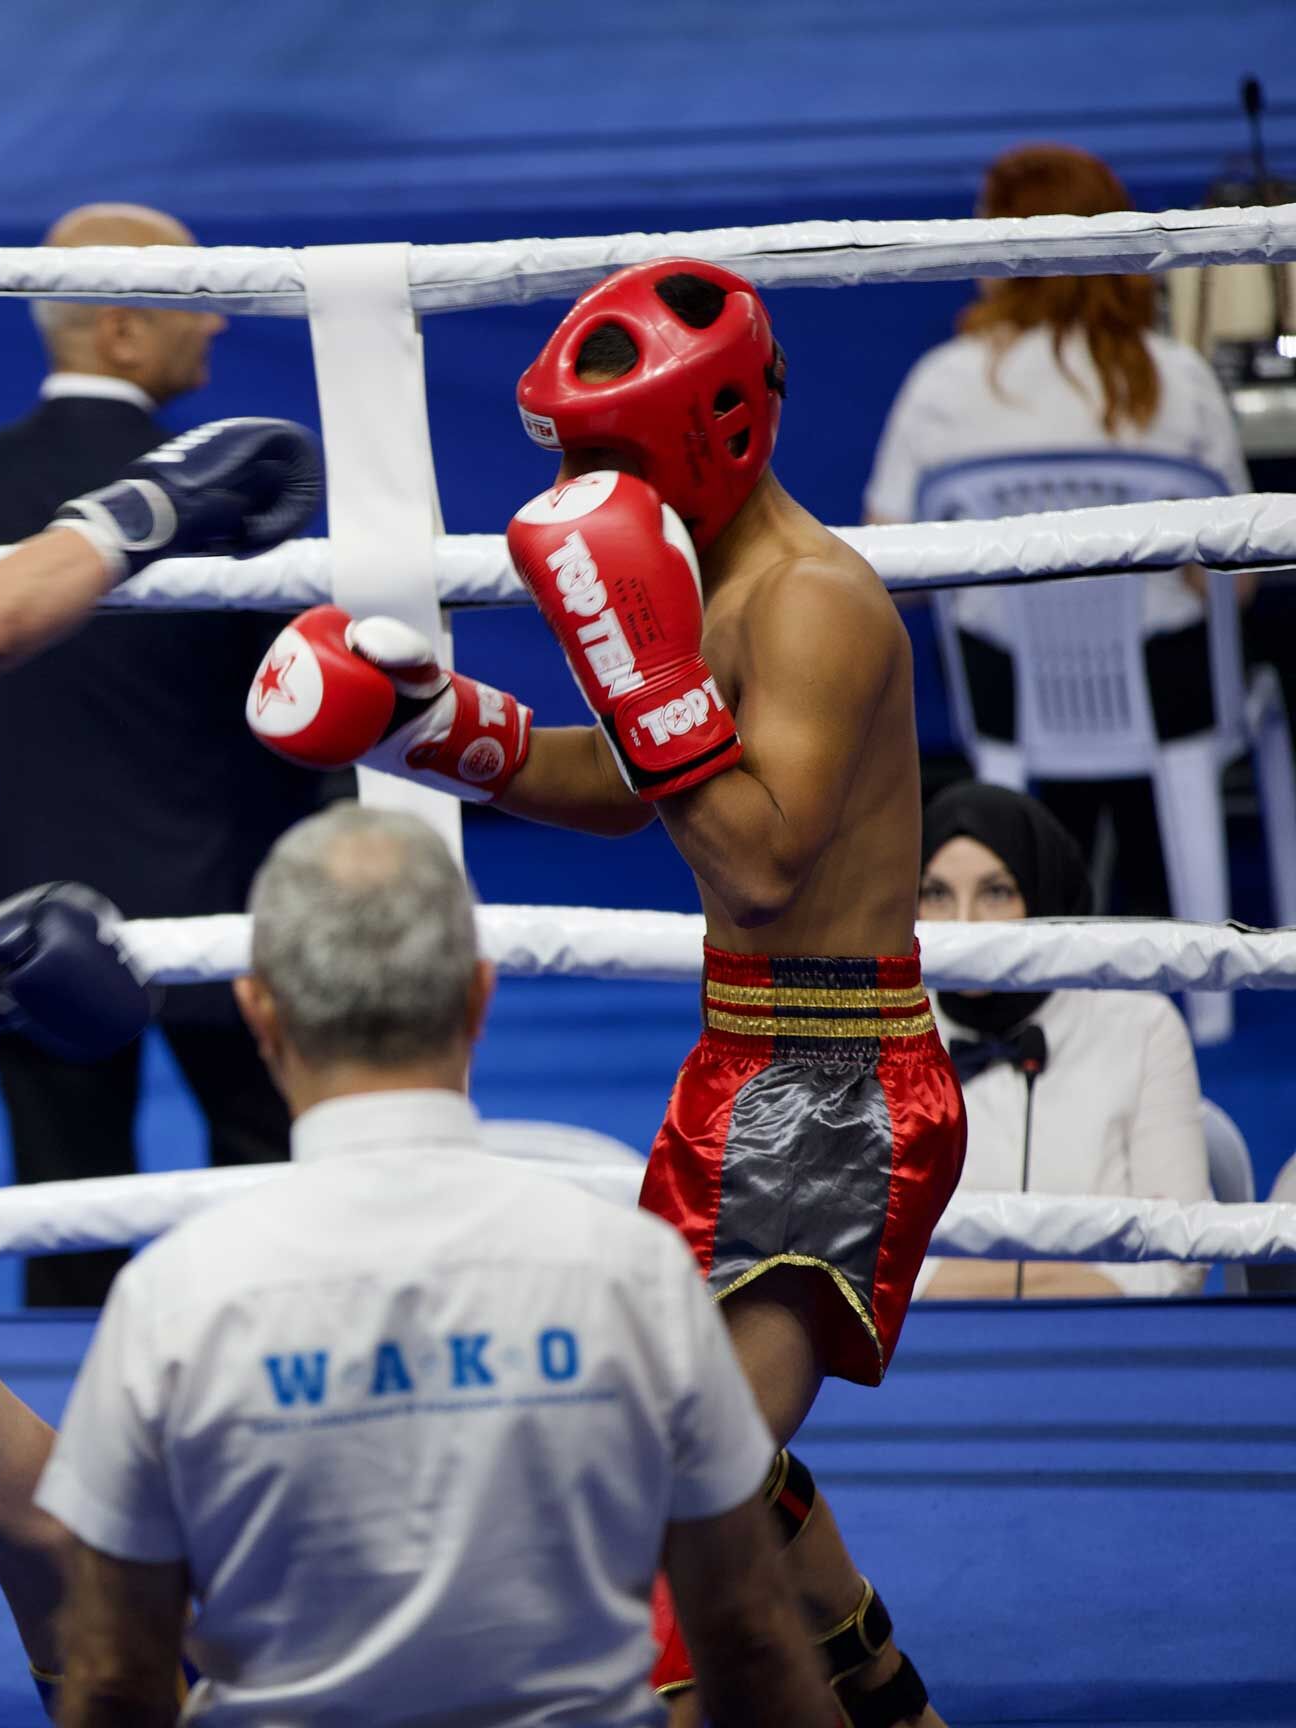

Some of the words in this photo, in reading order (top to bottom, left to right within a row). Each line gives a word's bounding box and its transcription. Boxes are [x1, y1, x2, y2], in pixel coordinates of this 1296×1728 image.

[545, 529, 608, 617] TOP
[576, 607, 646, 699] TEN
[637, 688, 710, 746] TOP
